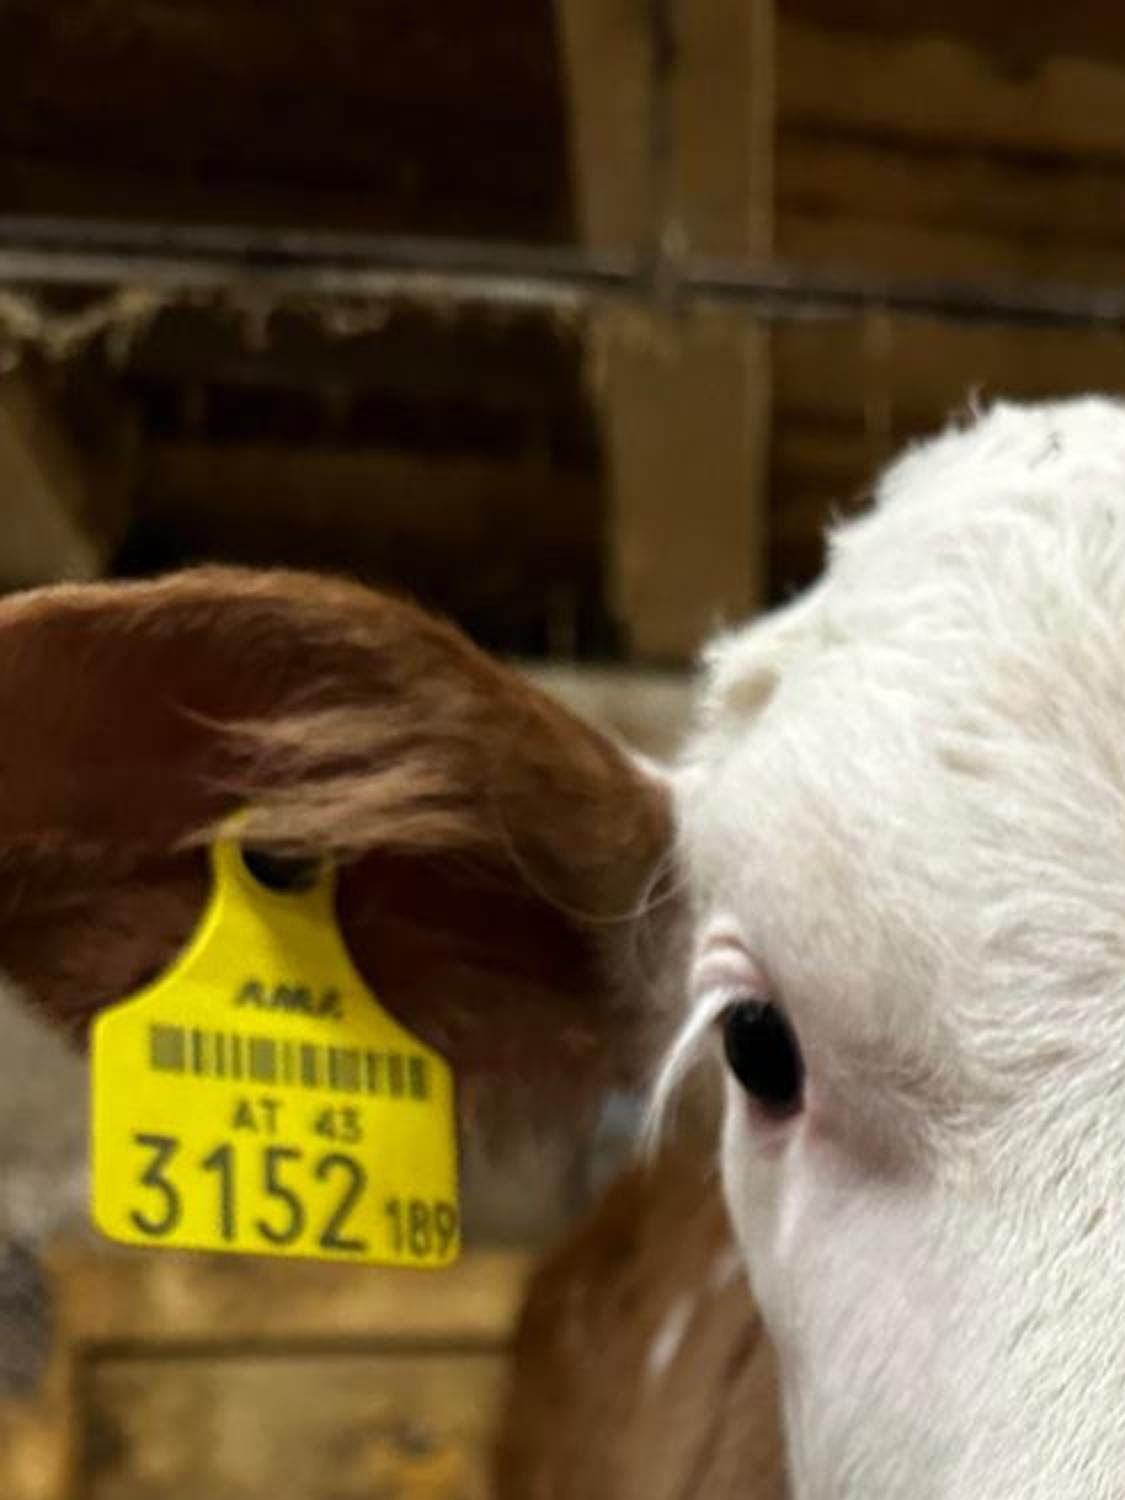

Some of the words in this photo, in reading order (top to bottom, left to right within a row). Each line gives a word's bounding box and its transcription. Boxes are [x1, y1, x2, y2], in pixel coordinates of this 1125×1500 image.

[231, 1099, 282, 1135] AT
[314, 1106, 364, 1144] 43
[130, 1133, 369, 1252] 3152
[384, 1199, 457, 1258] 189
